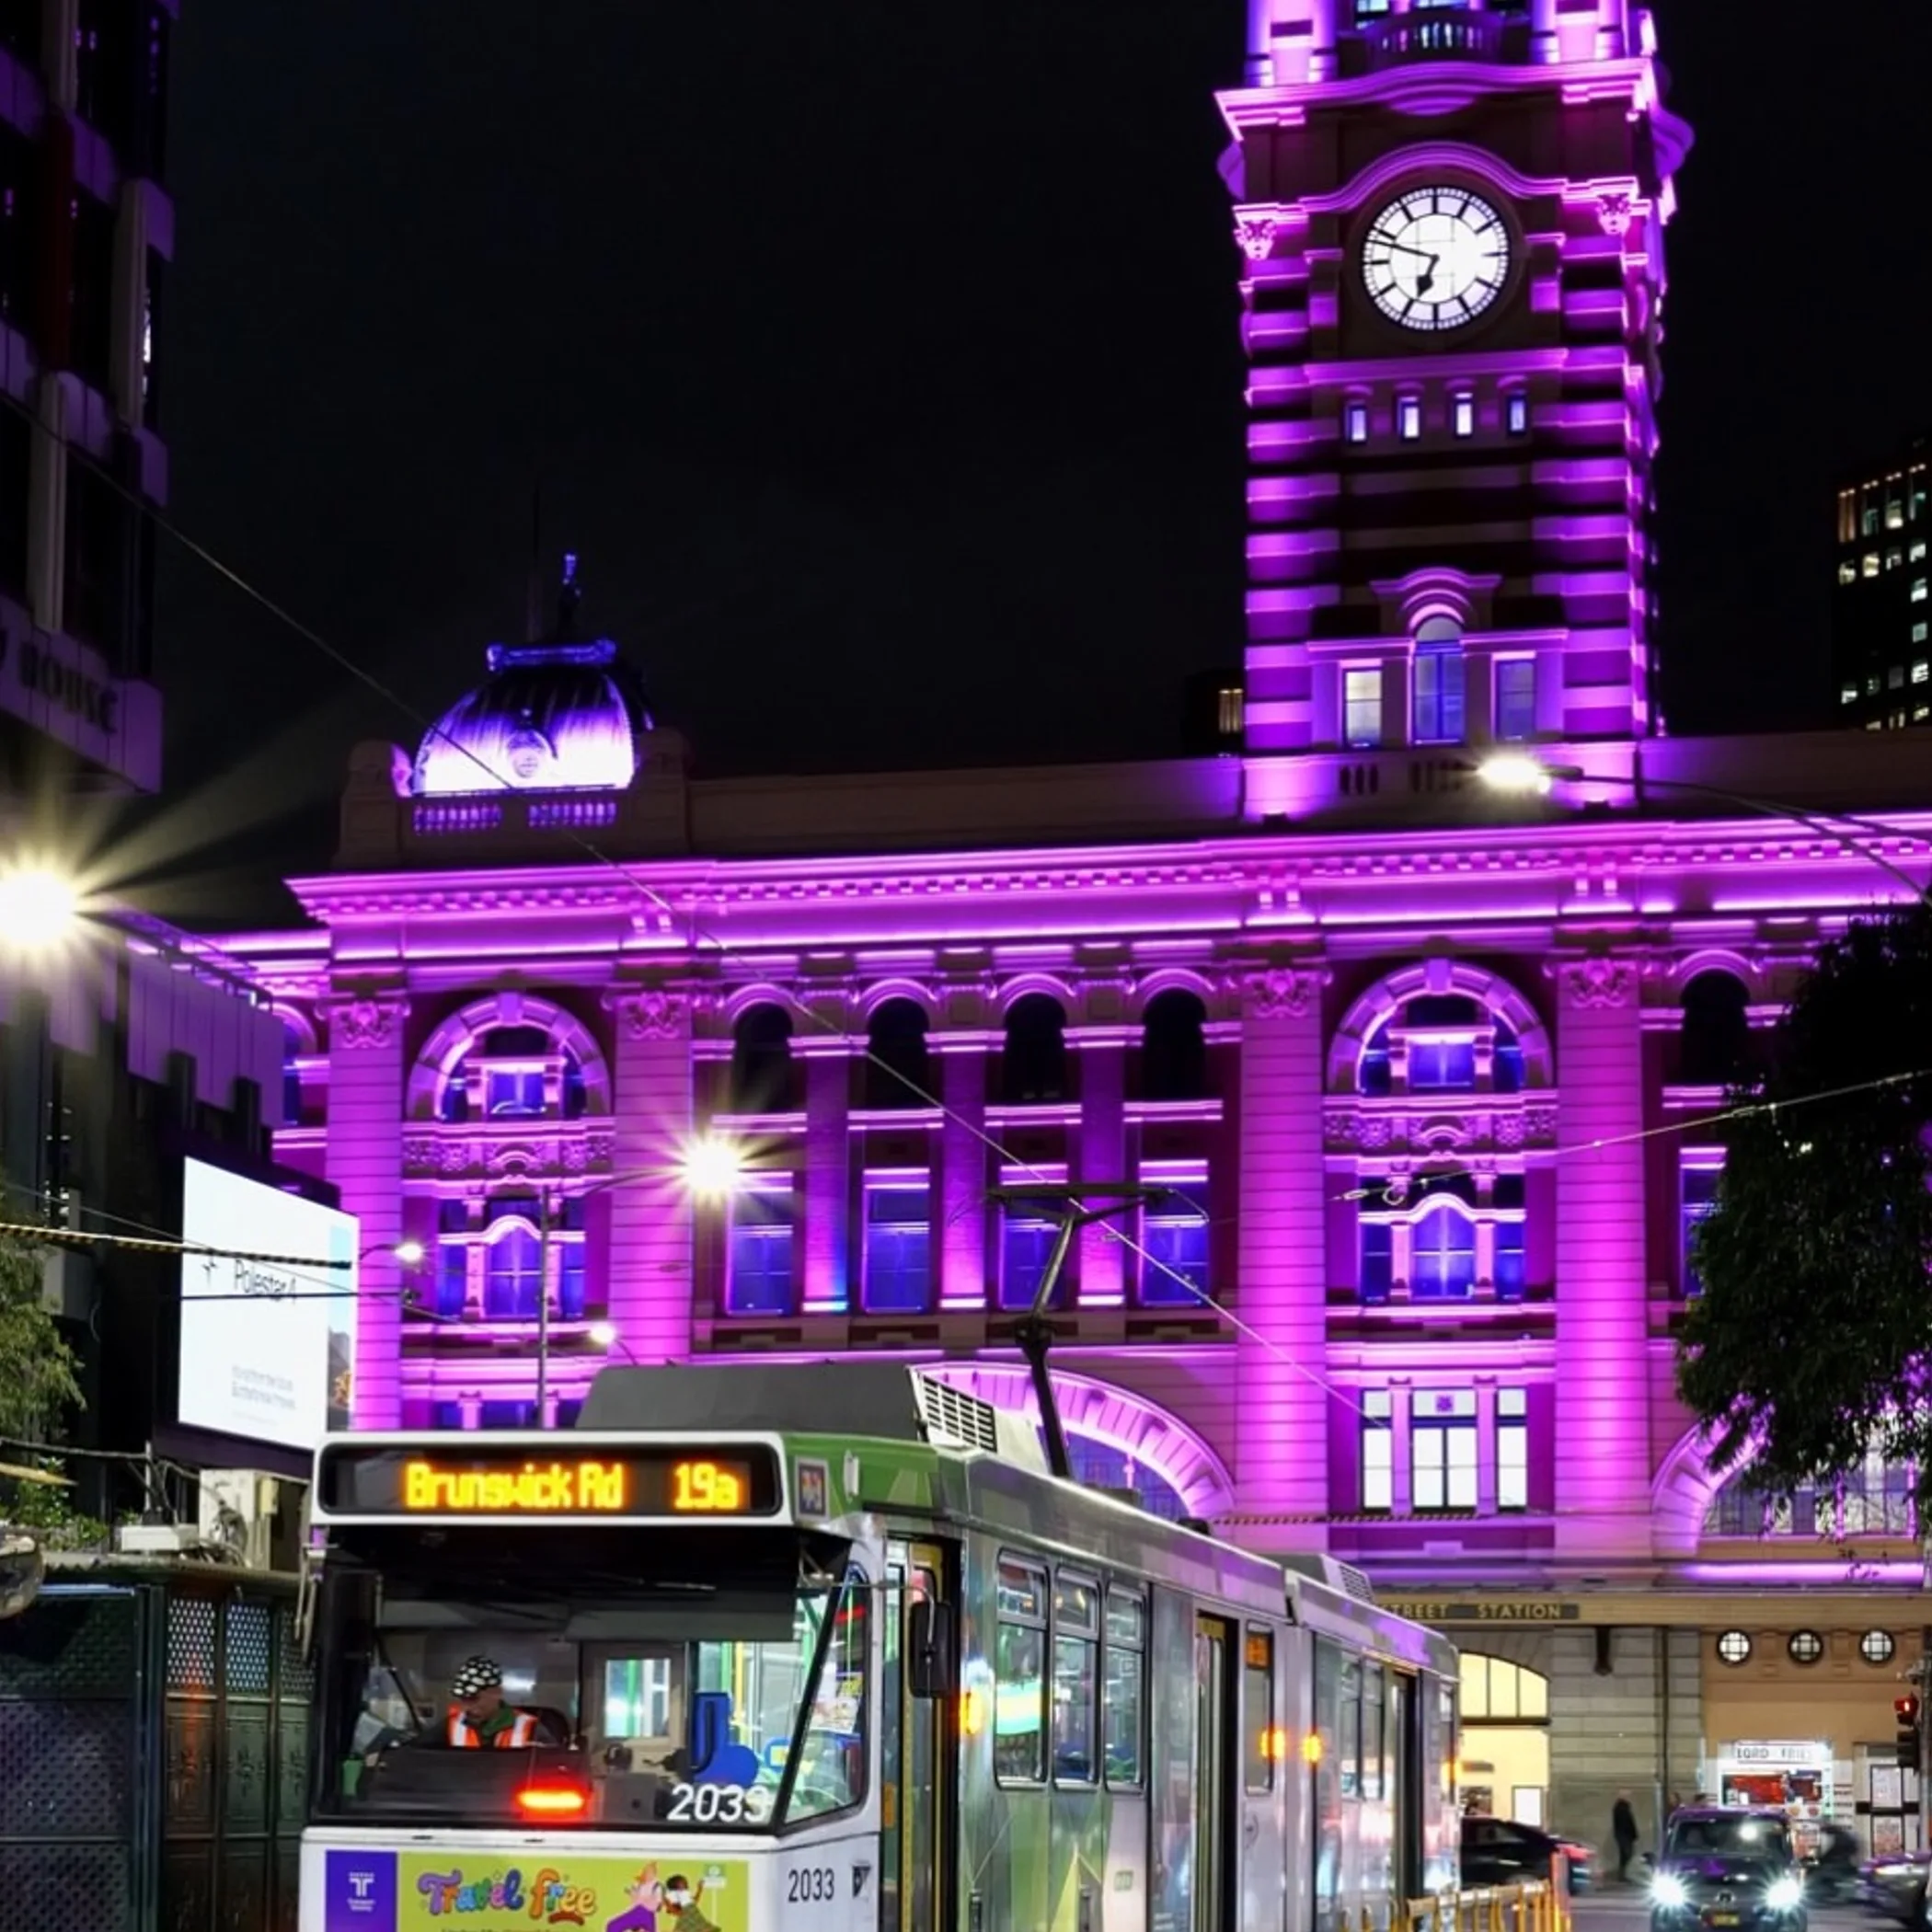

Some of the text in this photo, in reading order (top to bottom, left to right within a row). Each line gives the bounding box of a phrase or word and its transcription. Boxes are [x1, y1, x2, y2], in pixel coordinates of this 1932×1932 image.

[406, 1463, 739, 1509] Brunswick Rd 19a
[1478, 1604, 1561, 1618] STATION
[667, 1783, 770, 1822] 2033
[418, 1869, 524, 1915] Travel
[788, 1869, 834, 1902] 2033
